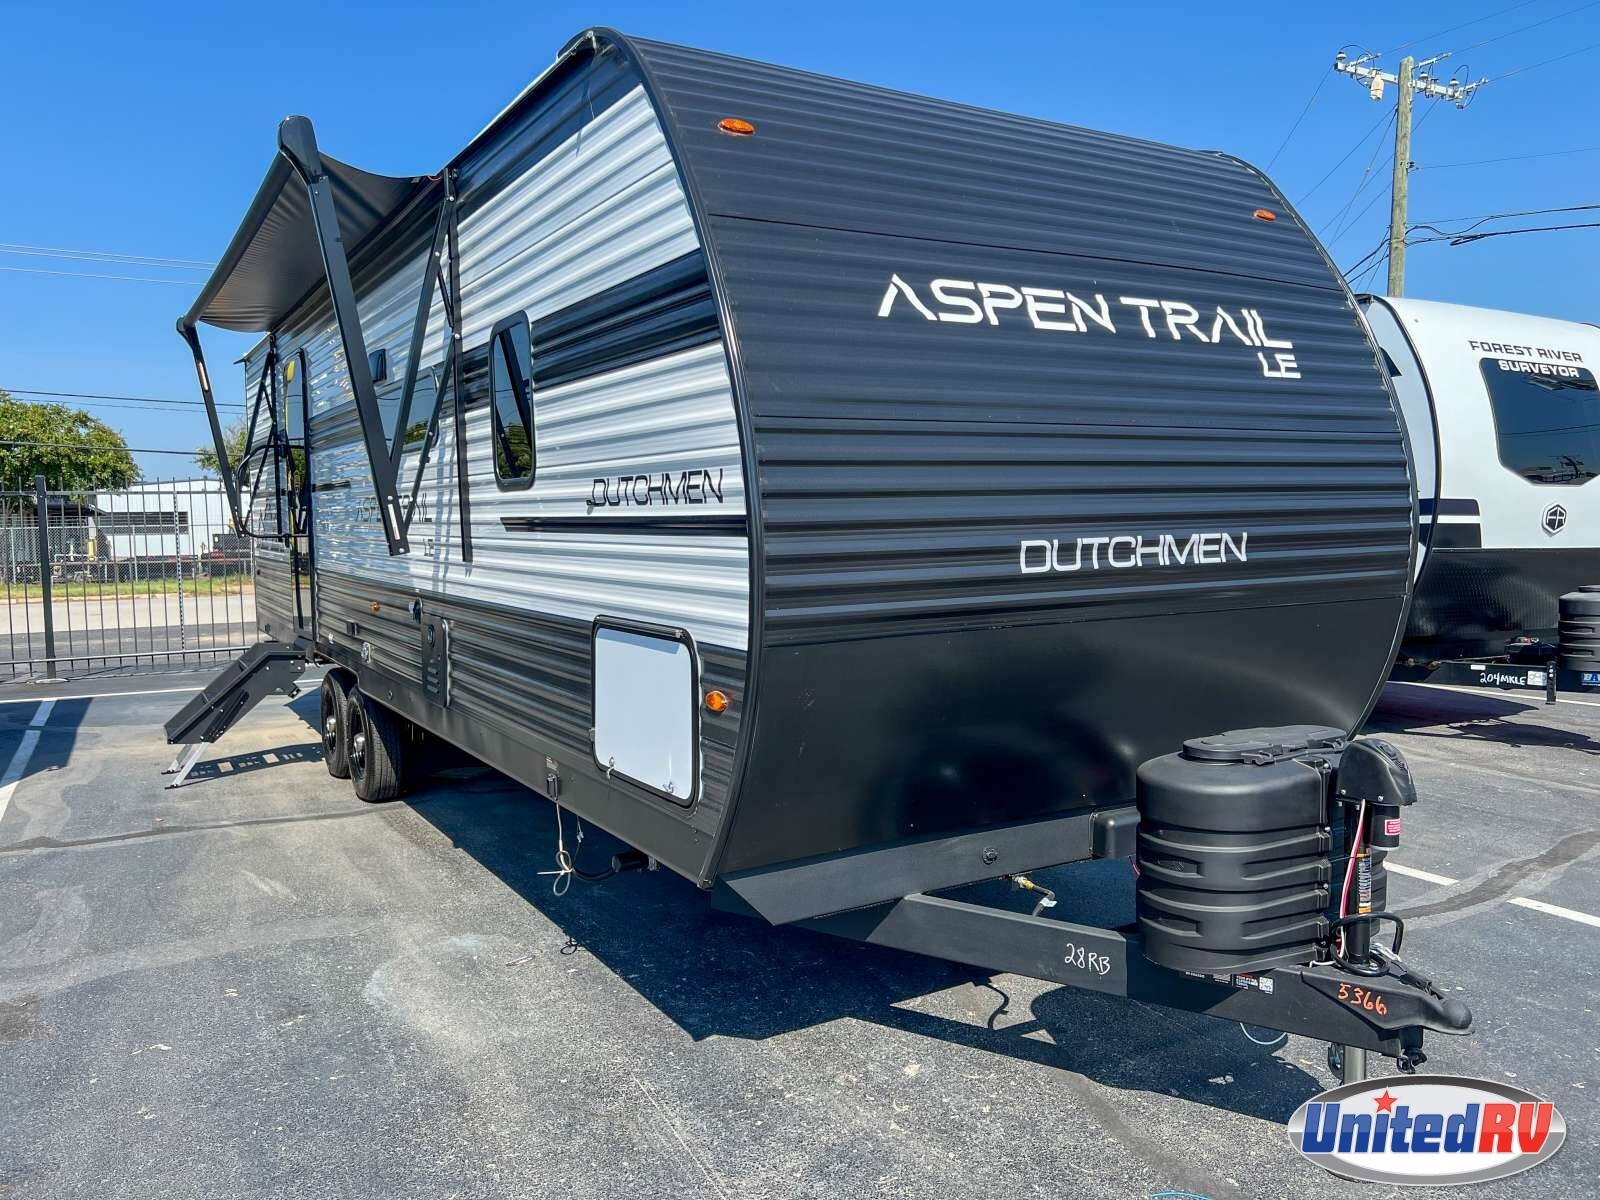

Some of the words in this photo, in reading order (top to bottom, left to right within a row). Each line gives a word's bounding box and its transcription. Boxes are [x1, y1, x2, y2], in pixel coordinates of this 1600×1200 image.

[878, 273, 1116, 334] ASPEN
[1119, 296, 1293, 348] TRAIL
[1257, 351, 1301, 378] LE
[1468, 339, 1532, 357] FOREST
[1536, 347, 1583, 363] RIVER
[1498, 359, 1580, 378] SURVEYOR
[591, 468, 724, 507] DUTCHMEN
[1020, 532, 1247, 574] DUTCHMEN
[1064, 943, 1111, 976] 28RB
[1338, 982, 1388, 1016] 5366
